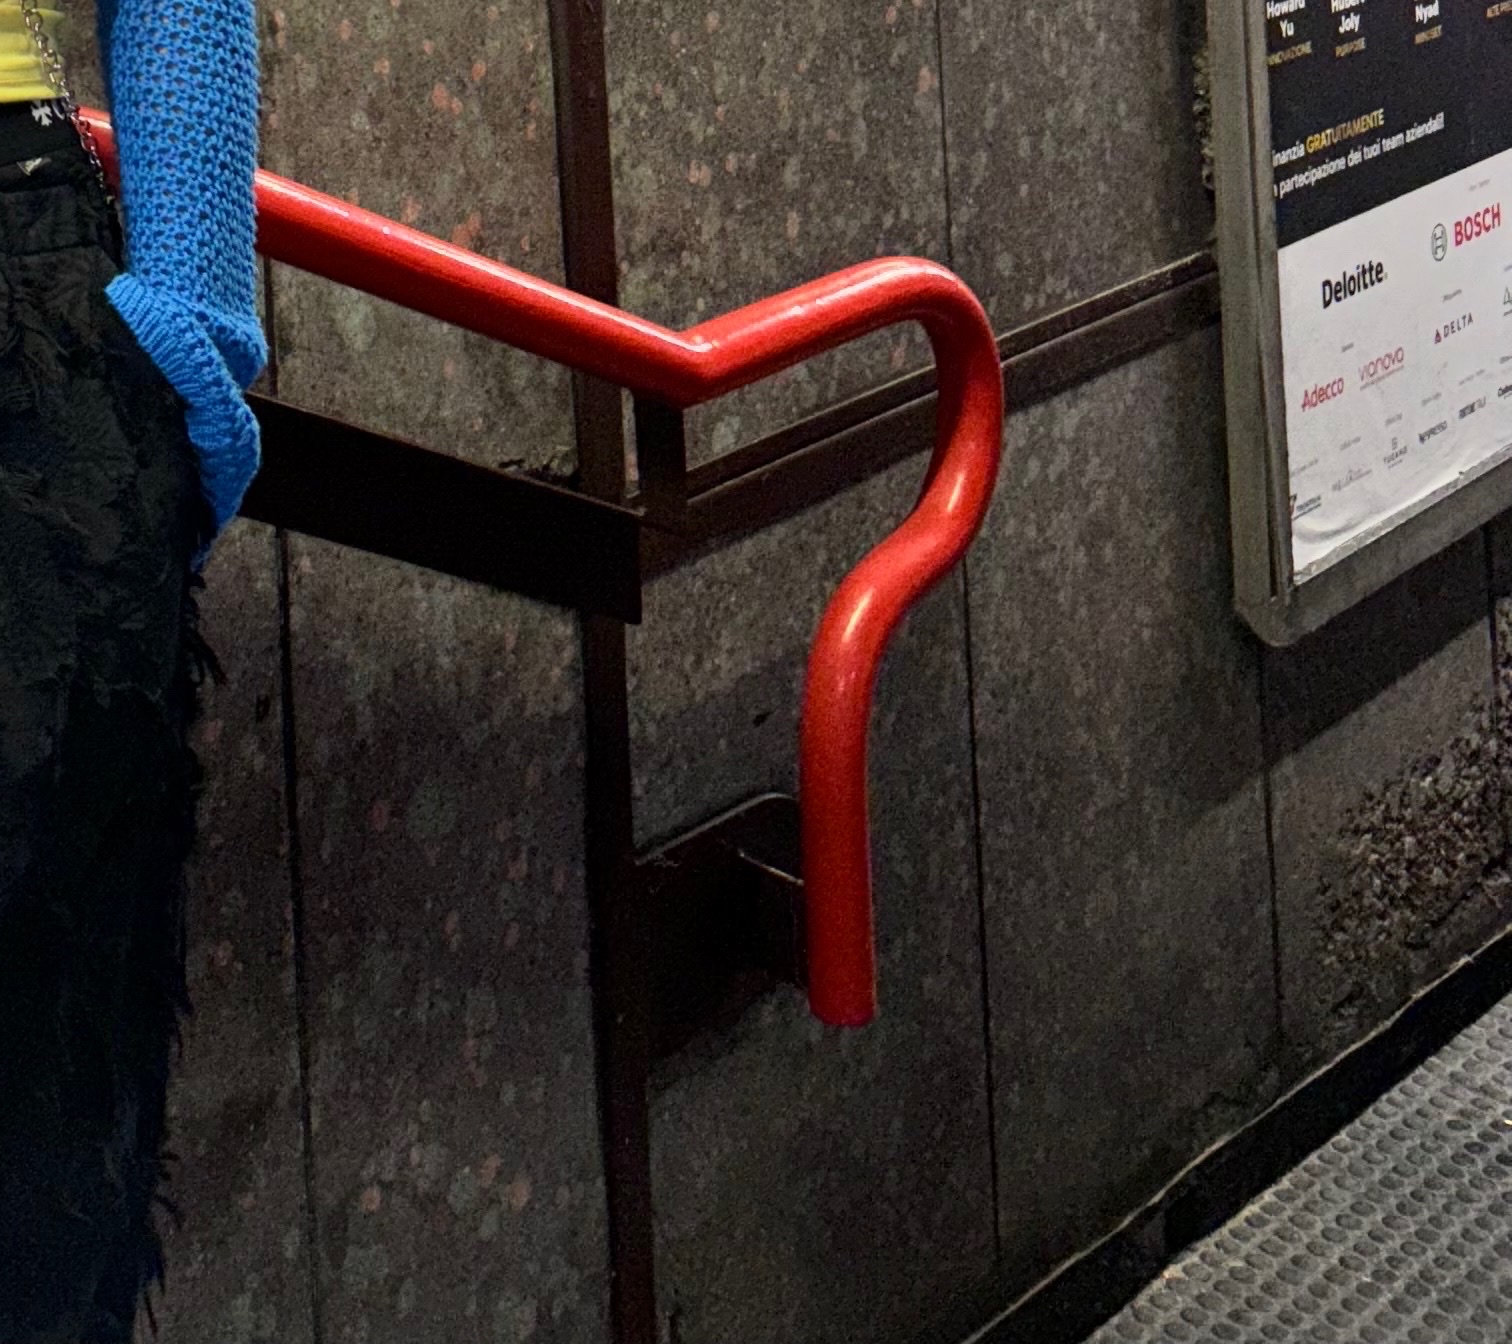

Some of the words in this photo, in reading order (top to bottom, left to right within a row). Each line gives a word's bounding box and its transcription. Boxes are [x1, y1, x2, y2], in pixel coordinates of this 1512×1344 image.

[1280, 19, 1294, 38] Yu
[1338, 12, 1361, 34] Joly
[1305, 108, 1385, 154] GRATUITAMENTE
[1279, 156, 1346, 199] partecipazione
[1381, 133, 1405, 153] team
[1453, 202, 1501, 247] BOSCH
[1443, 312, 1474, 339] DELTA
[1301, 377, 1345, 413] Adecco
